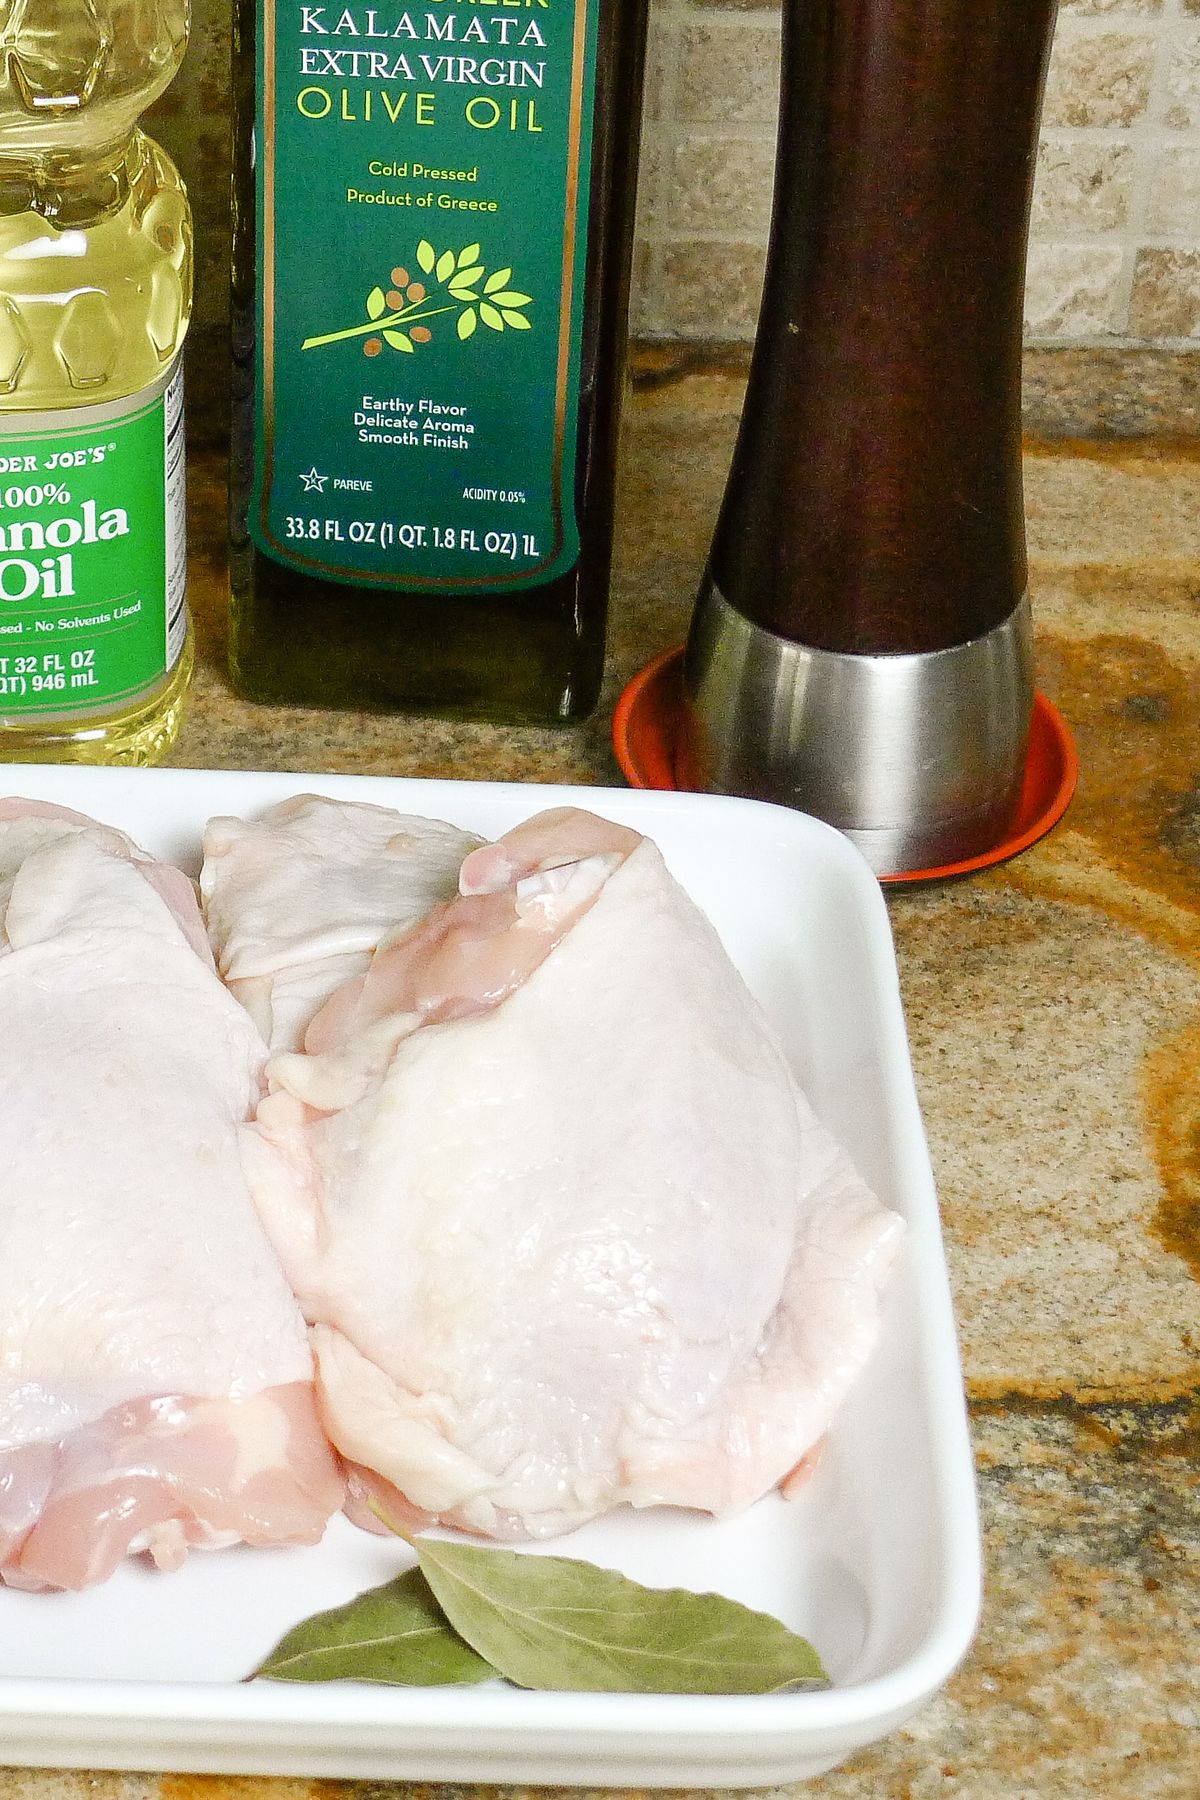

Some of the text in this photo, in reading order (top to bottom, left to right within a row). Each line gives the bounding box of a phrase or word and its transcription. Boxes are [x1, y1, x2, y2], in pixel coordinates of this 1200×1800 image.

[300, 7, 547, 47] KALAMATA
[299, 48, 547, 88] EXTRA VIRGIN
[296, 86, 543, 133] OLIVE OIL
[368, 161, 478, 183] Cold Pressed
[346, 188, 498, 213] Product of Greece
[362, 396, 467, 417] Earthy Flavor
[354, 412, 475, 434] Delicate Aroma
[358, 429, 469, 450] Smooth Finish
[333, 478, 373, 492] PAREVE
[462, 488, 526, 504] ACIDITY 0.05%
[286, 516, 540, 560] 33.8 FL OZ (1 QT. 1.8 FL OZ) 1L
[34, 620, 55, 632] No
[57, 613, 111, 630] Solvents
[113, 600, 142, 619] Used
[14, 656, 38, 673] 32
[43, 654, 65, 672] FL
[71, 650, 96, 667] OZ
[32, 673, 66, 692] 946
[71, 669, 99, 687] mL
